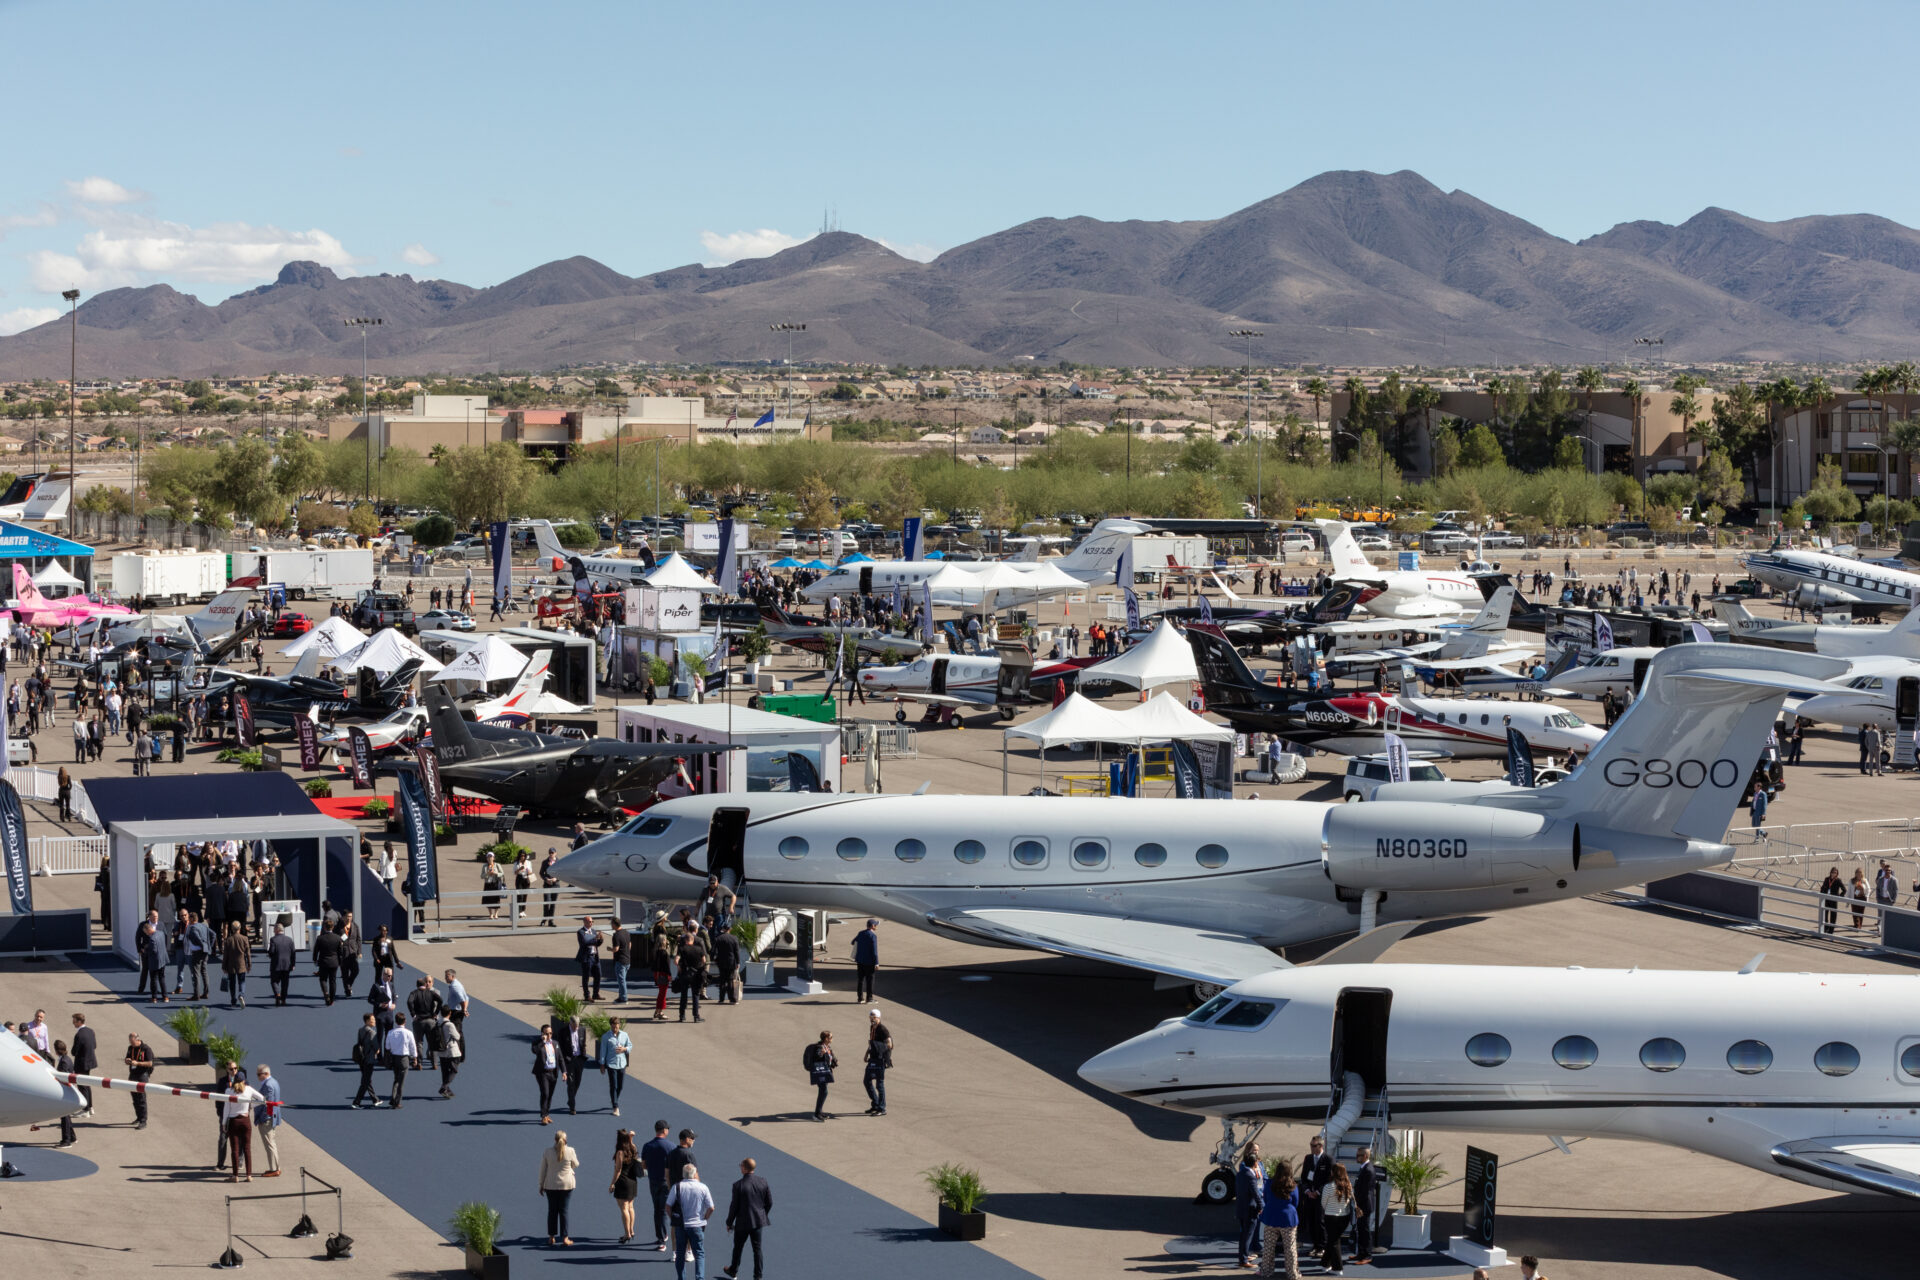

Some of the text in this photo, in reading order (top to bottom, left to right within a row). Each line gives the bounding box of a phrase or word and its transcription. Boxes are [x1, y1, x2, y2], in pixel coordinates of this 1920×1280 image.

[1821, 561, 1871, 579] VAERUS
[1877, 575, 1896, 585] JET
[664, 608, 694, 619] Piper
[1515, 682, 1543, 691] N423US
[1305, 711, 1350, 723] N606CB
[302, 720, 315, 765] DAHER
[440, 744, 467, 760] N321
[355, 735, 368, 780] DAHER
[1603, 758, 1739, 789] G800
[5, 812, 26, 900] Gulfstream
[410, 800, 428, 886] Gulfstream
[1376, 838, 1468, 858] N803GD
[1482, 1160, 1496, 1241] G700
